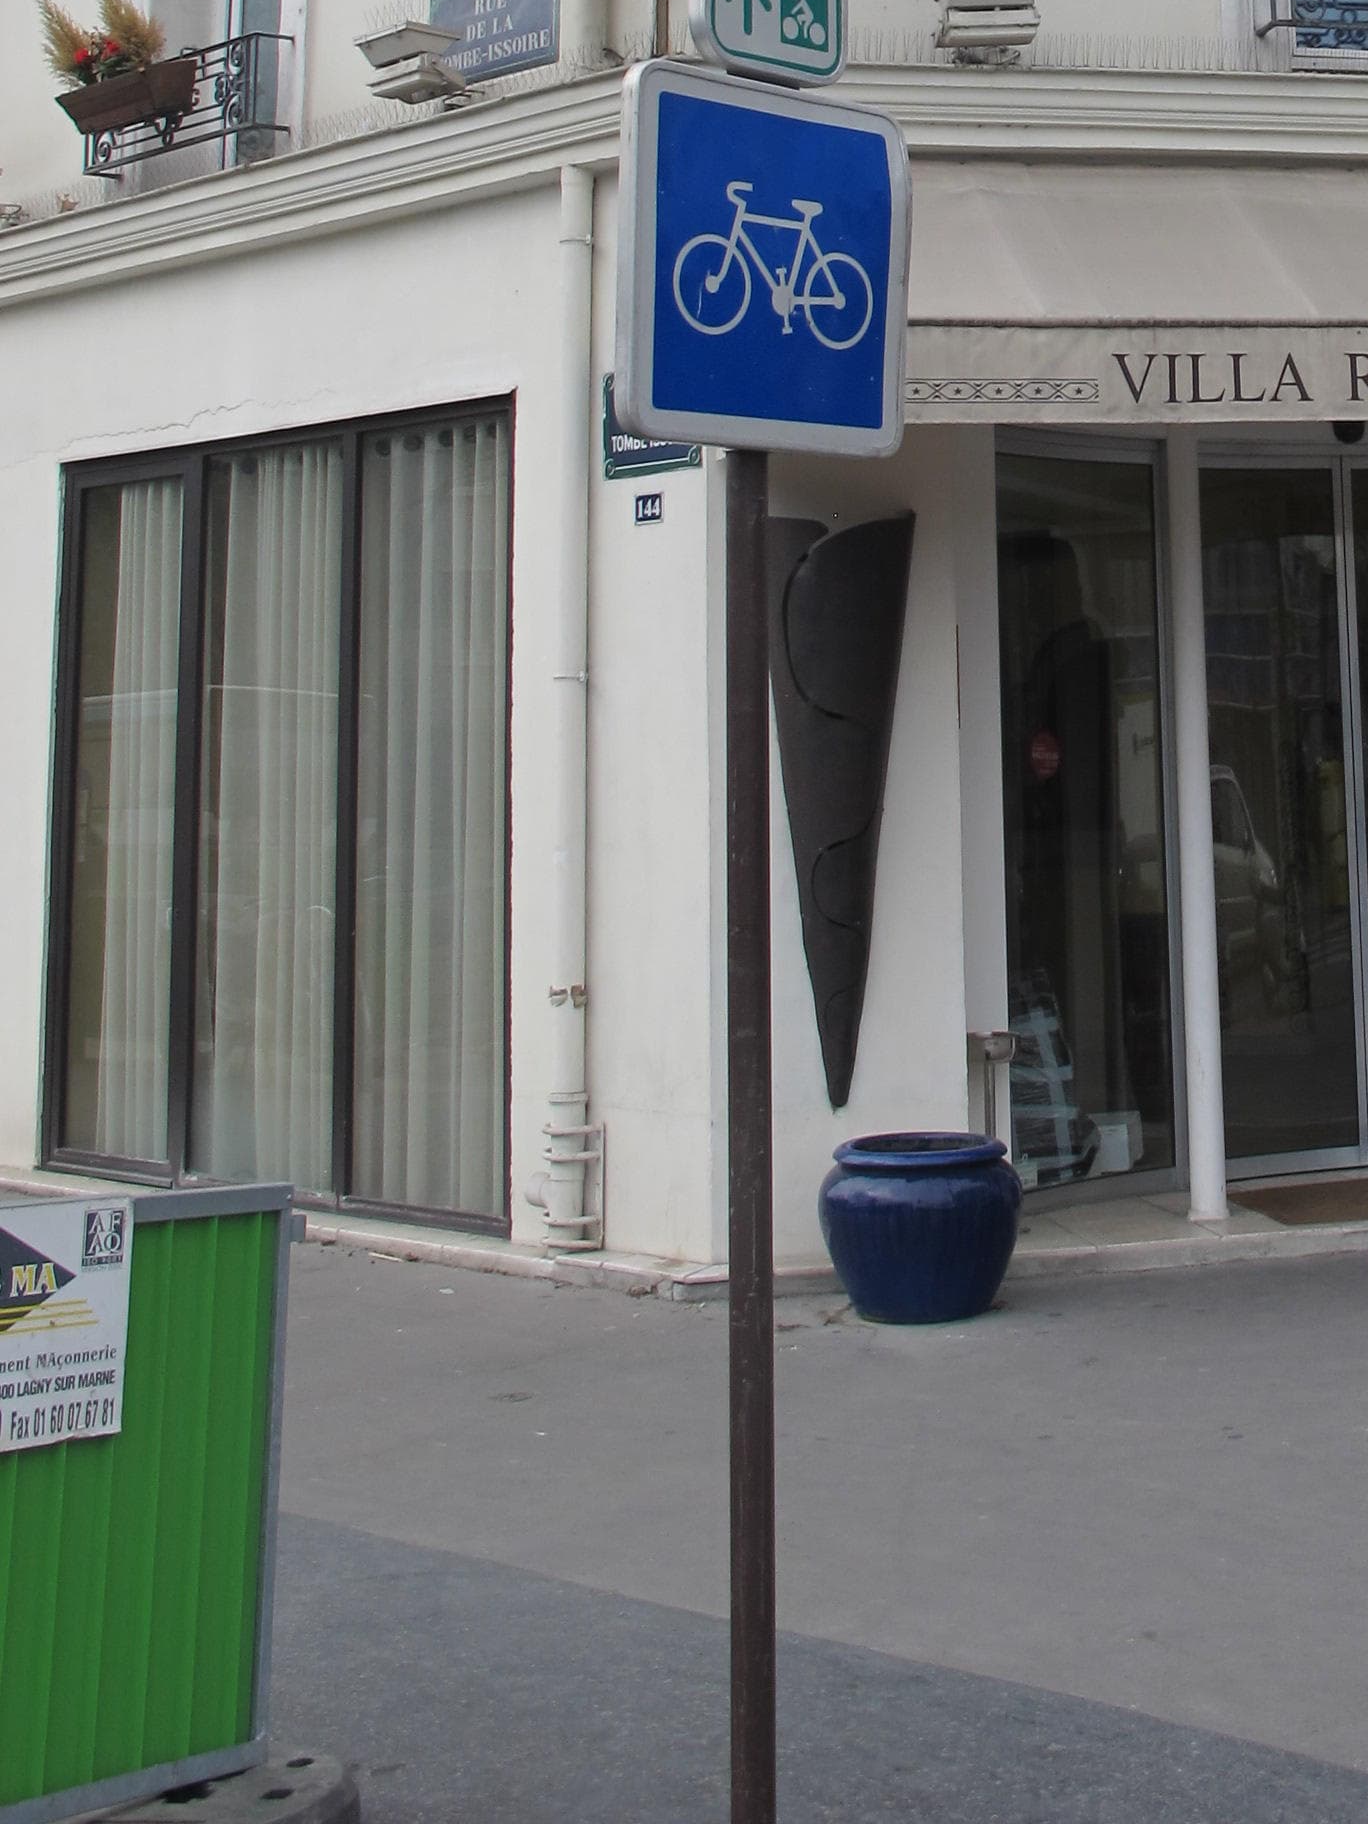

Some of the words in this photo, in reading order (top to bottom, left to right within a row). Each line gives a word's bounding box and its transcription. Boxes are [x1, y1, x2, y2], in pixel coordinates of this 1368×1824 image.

[465, 19, 487, 43] DE
[492, 13, 514, 36] LA
[443, 28, 551, 70] OMBE-ISSOIRE
[1112, 351, 1315, 405] VILLA
[637, 497, 661, 519] 144
[17, 1378, 52, 1397] LAGNY
[54, 1375, 76, 1393] SUR
[78, 1369, 117, 1388] MARNE
[11, 1410, 30, 1440] Fax
[33, 1407, 46, 1437] 01
[50, 1404, 64, 1434] 60
[67, 1401, 82, 1431] 07
[85, 1399, 99, 1429] 67
[102, 1397, 115, 1427] 81
